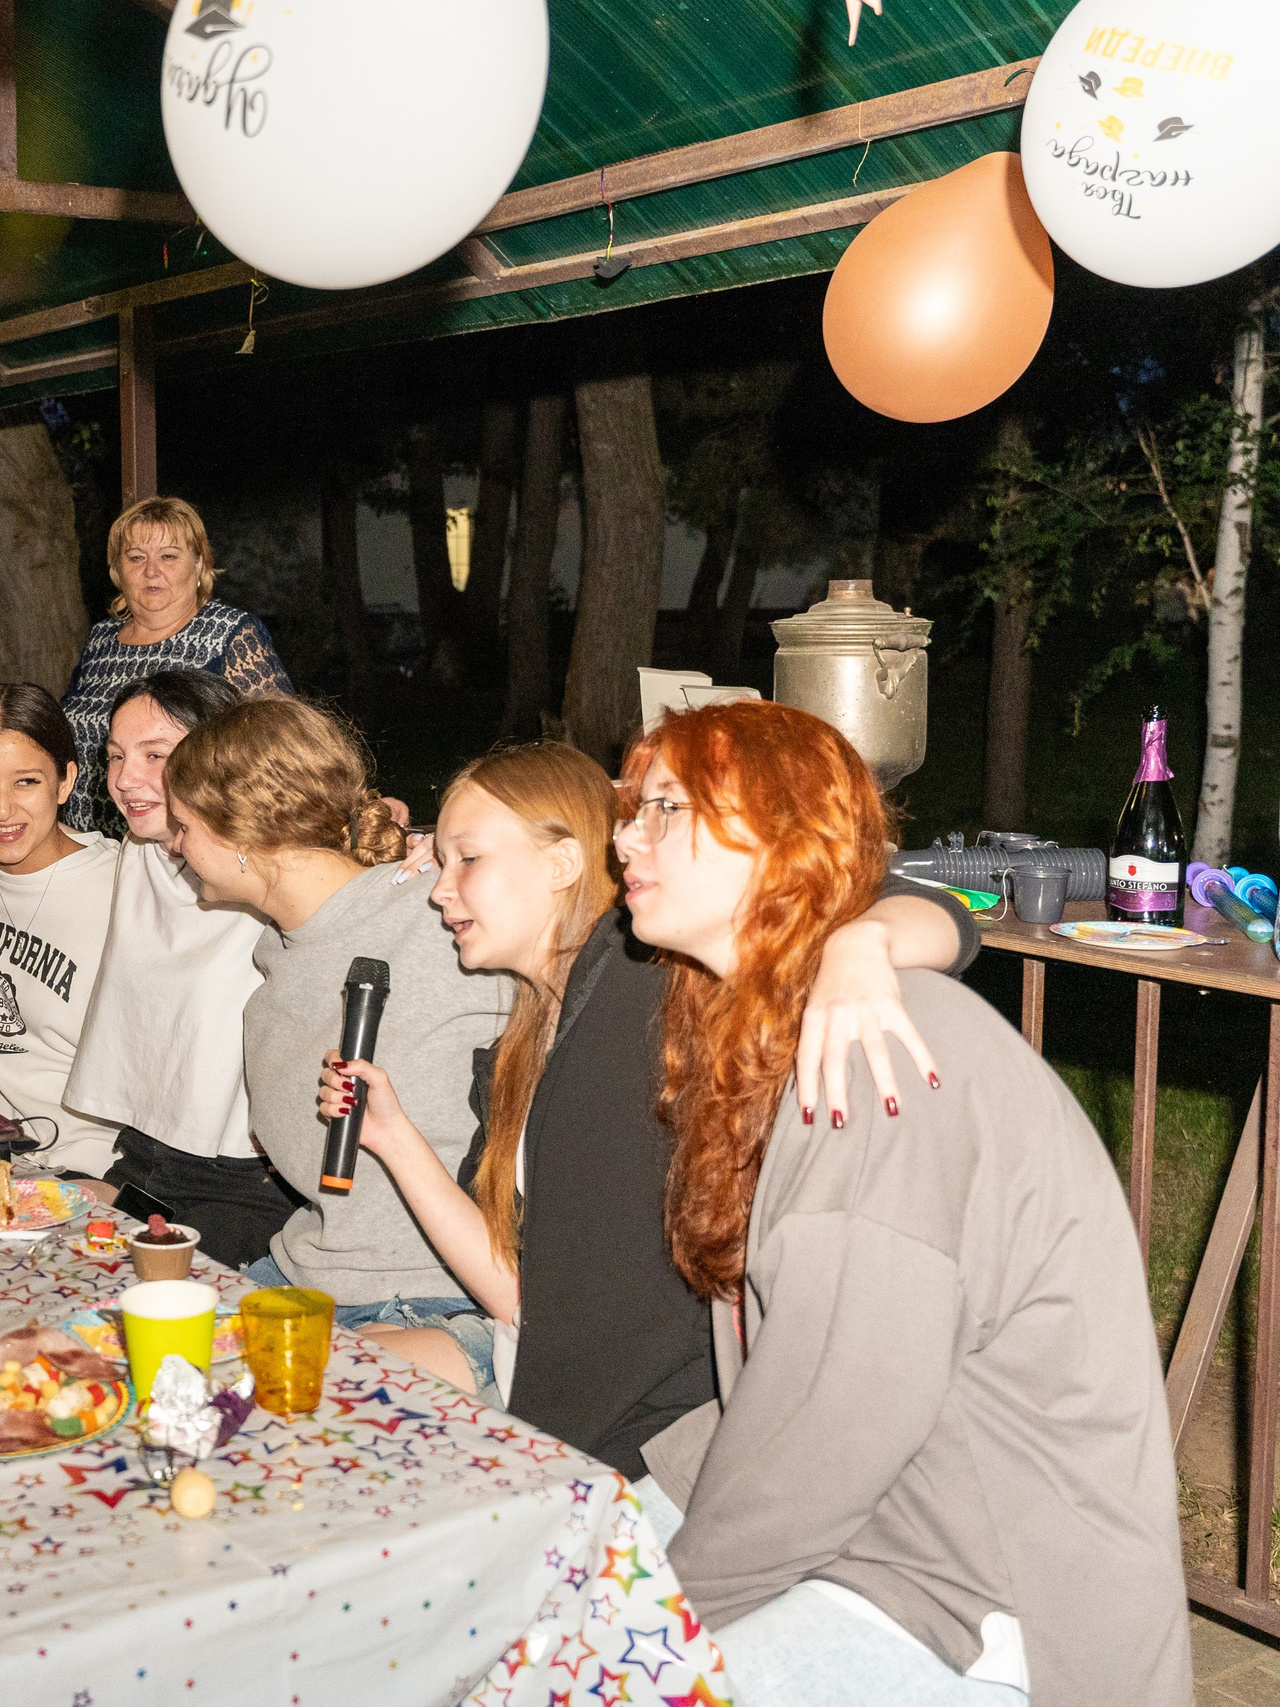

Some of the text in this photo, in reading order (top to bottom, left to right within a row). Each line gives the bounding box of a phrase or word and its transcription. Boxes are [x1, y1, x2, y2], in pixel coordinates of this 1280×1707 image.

[1082, 26, 1234, 81] ВПЕРЕДИ
[1045, 136, 1194, 187] награда
[1081, 181, 1141, 219] Твоя
[1110, 879, 1168, 891] ANTO STEFANO
